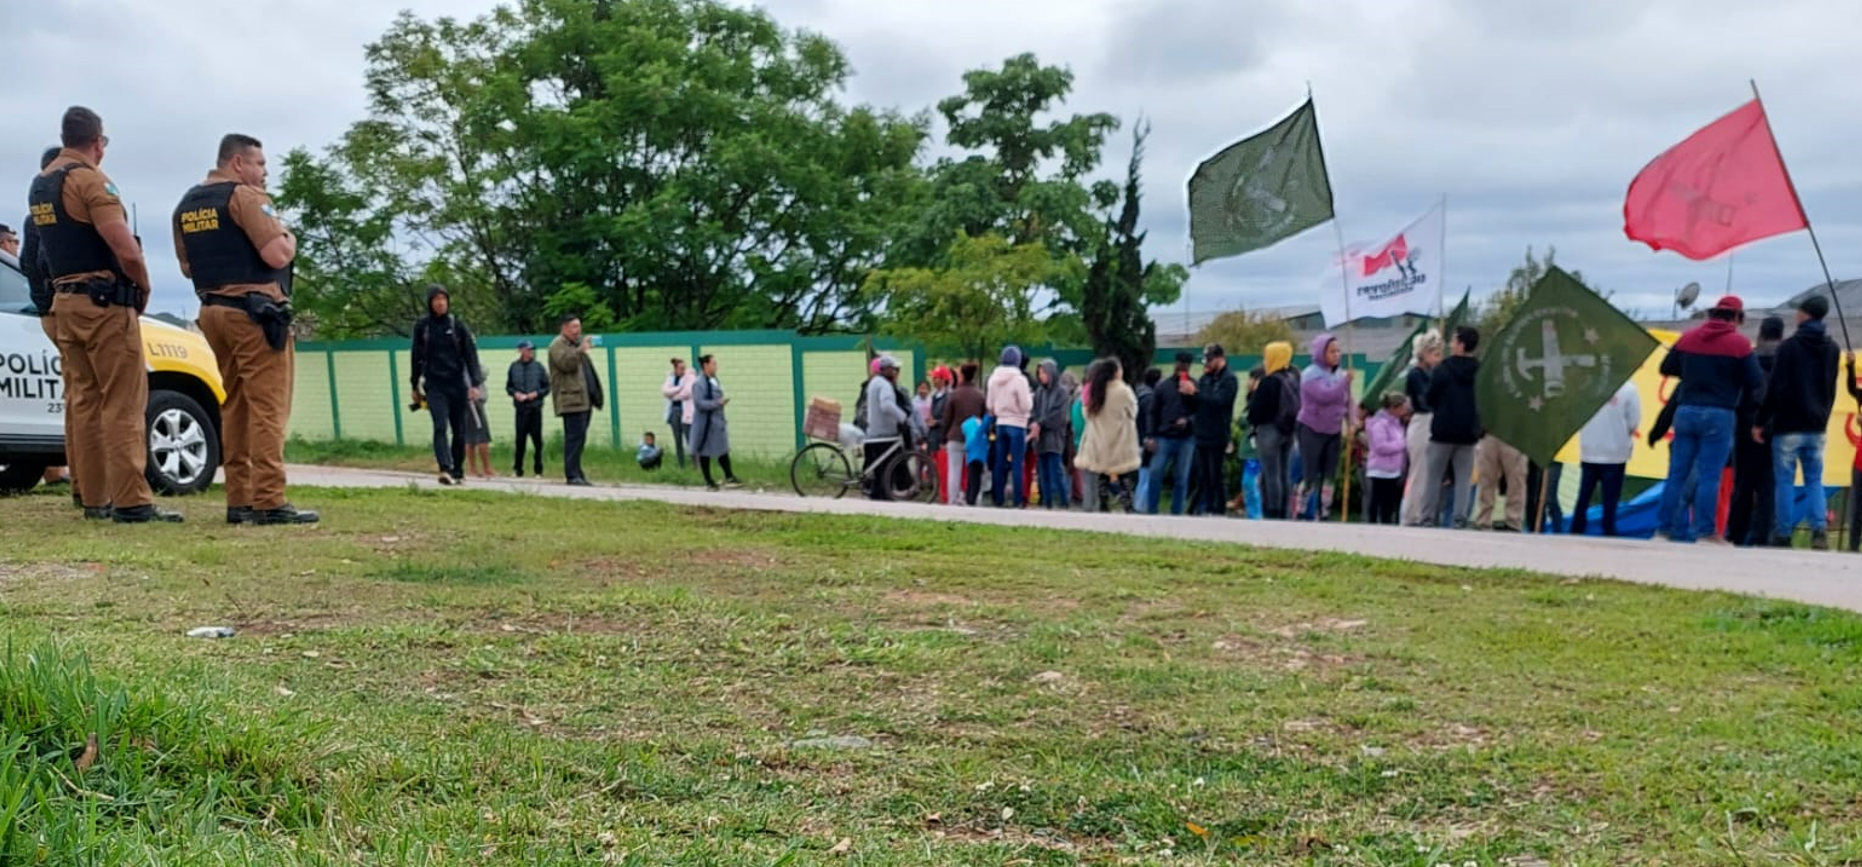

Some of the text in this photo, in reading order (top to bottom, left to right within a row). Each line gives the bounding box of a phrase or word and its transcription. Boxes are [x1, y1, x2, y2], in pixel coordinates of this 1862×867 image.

[181, 208, 217, 222] POLÍCIA
[183, 219, 219, 233] MILITAR
[147, 342, 188, 359] L1119
[0, 377, 65, 399] MILIT
[47, 402, 65, 413] 23
